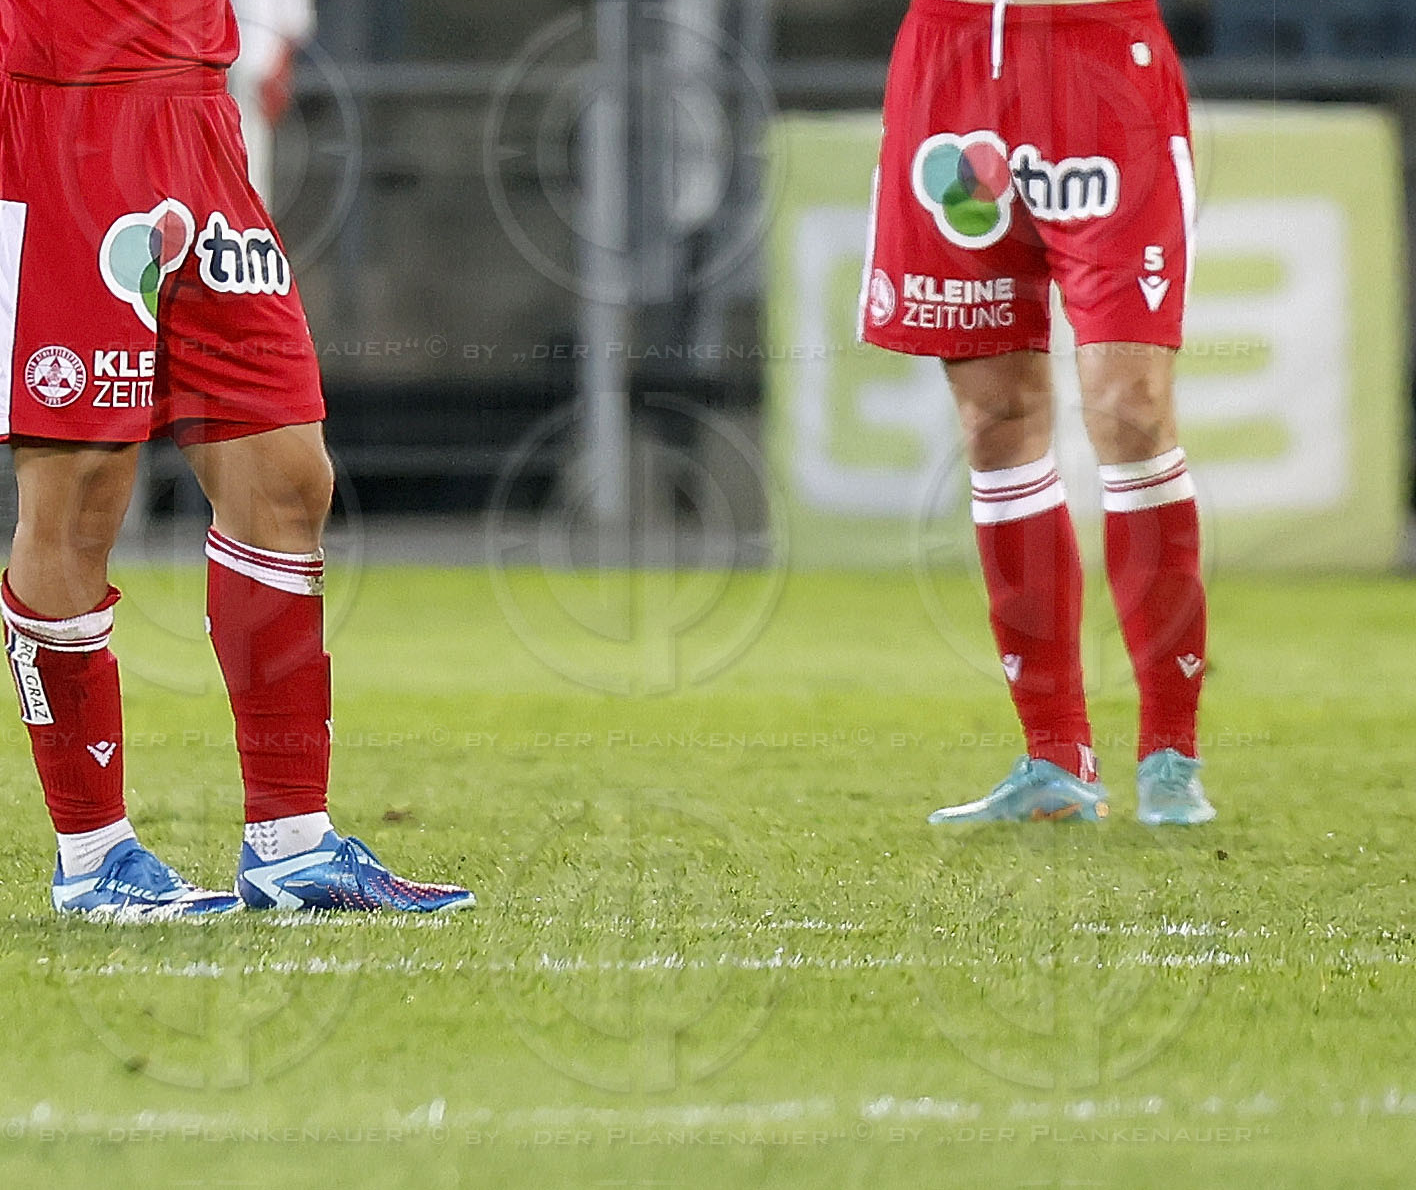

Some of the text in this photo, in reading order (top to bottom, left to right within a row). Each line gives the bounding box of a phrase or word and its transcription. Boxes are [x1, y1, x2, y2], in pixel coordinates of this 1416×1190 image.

[1144, 246, 1165, 271] 5
[903, 273, 1016, 305] KLEINE
[902, 303, 1016, 329] ZEITUNG
[94, 350, 155, 377] KLE
[25, 675, 50, 720] GRAZ
